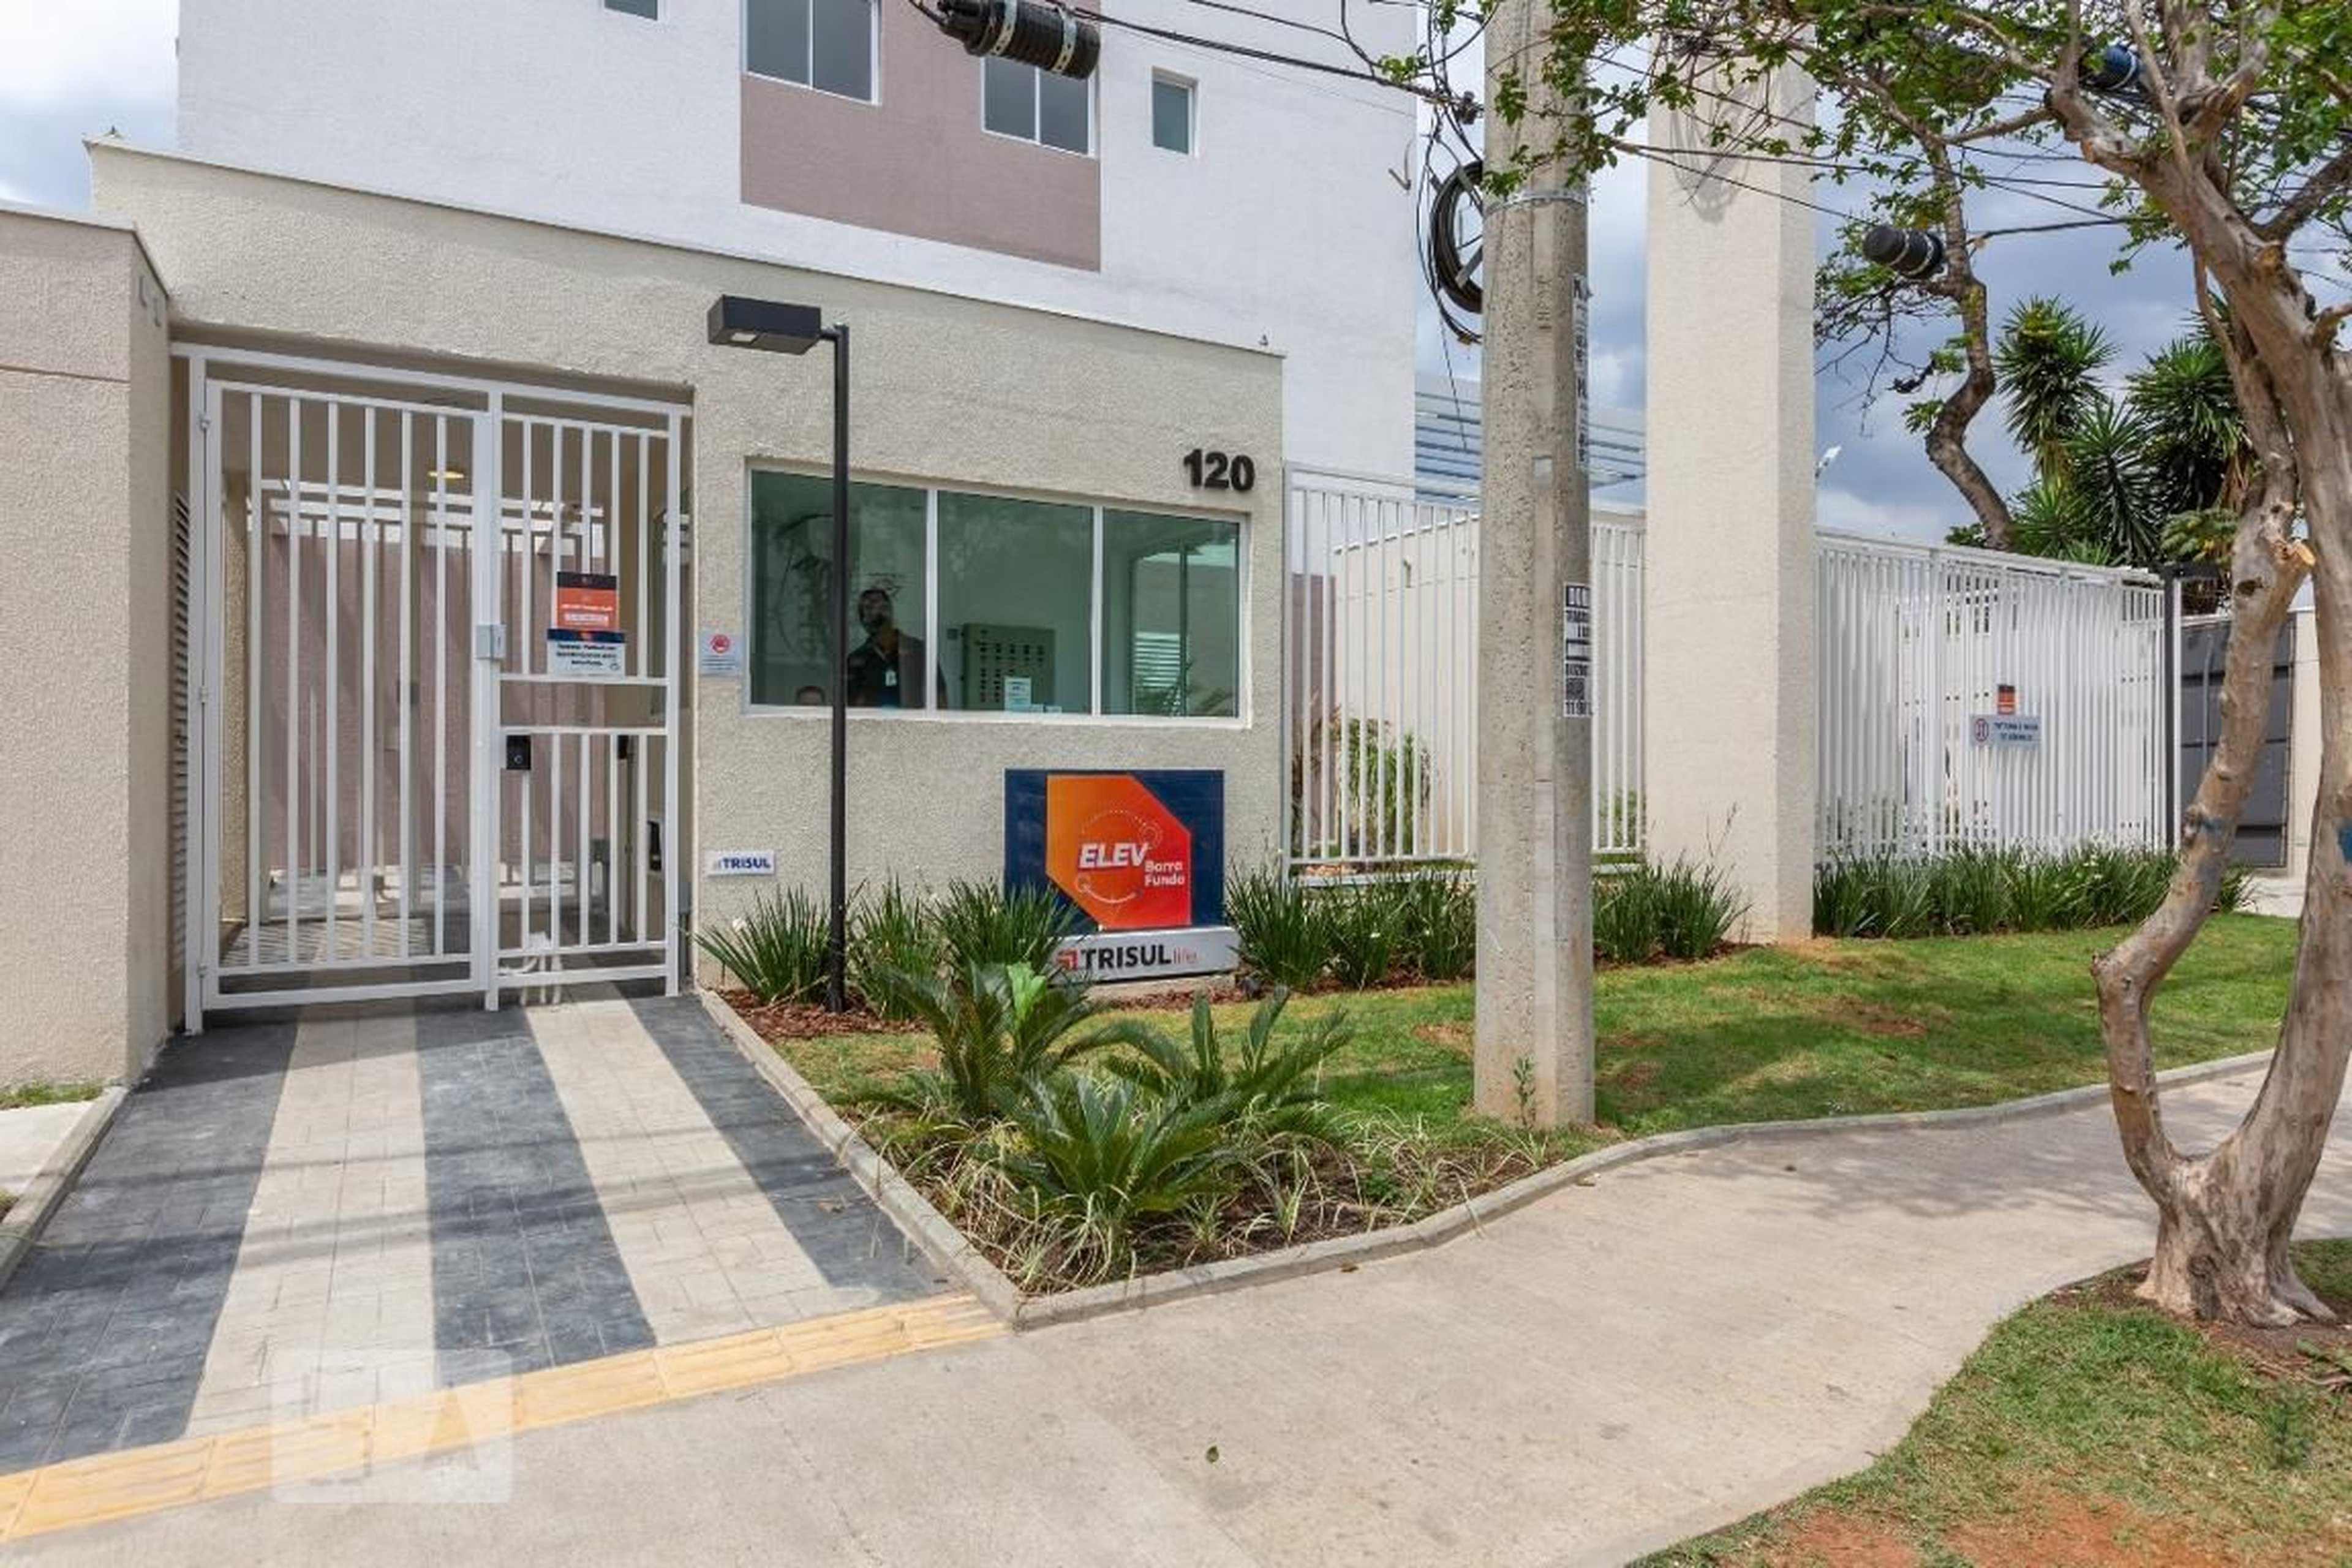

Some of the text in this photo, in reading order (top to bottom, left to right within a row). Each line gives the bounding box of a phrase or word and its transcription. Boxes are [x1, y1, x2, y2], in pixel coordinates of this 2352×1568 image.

[1183, 448, 1256, 491] 120
[722, 857, 771, 869] TRISUL
[1080, 843, 1150, 868] ELEV
[1080, 945, 1172, 970] TRISUL
